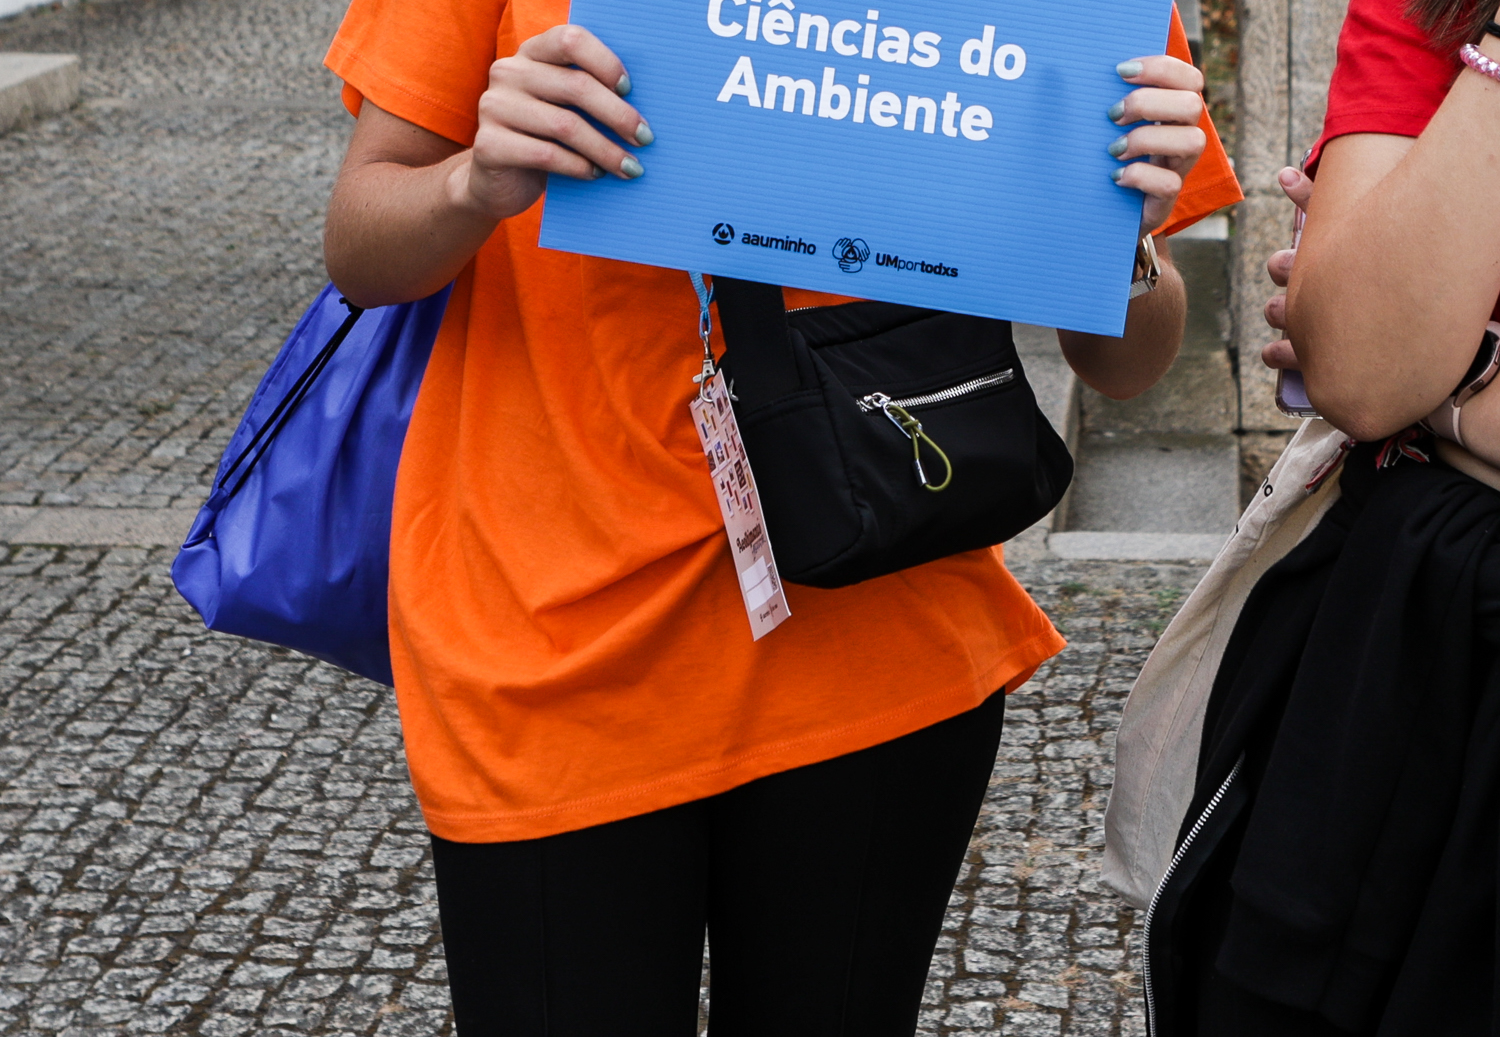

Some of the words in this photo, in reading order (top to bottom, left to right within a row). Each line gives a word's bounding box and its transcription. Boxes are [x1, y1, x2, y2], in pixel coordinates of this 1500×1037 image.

[960, 25, 1027, 81] do
[716, 55, 993, 142] Ambiente
[741, 231, 817, 256] aauminho
[875, 252, 959, 279] UMportodxs
